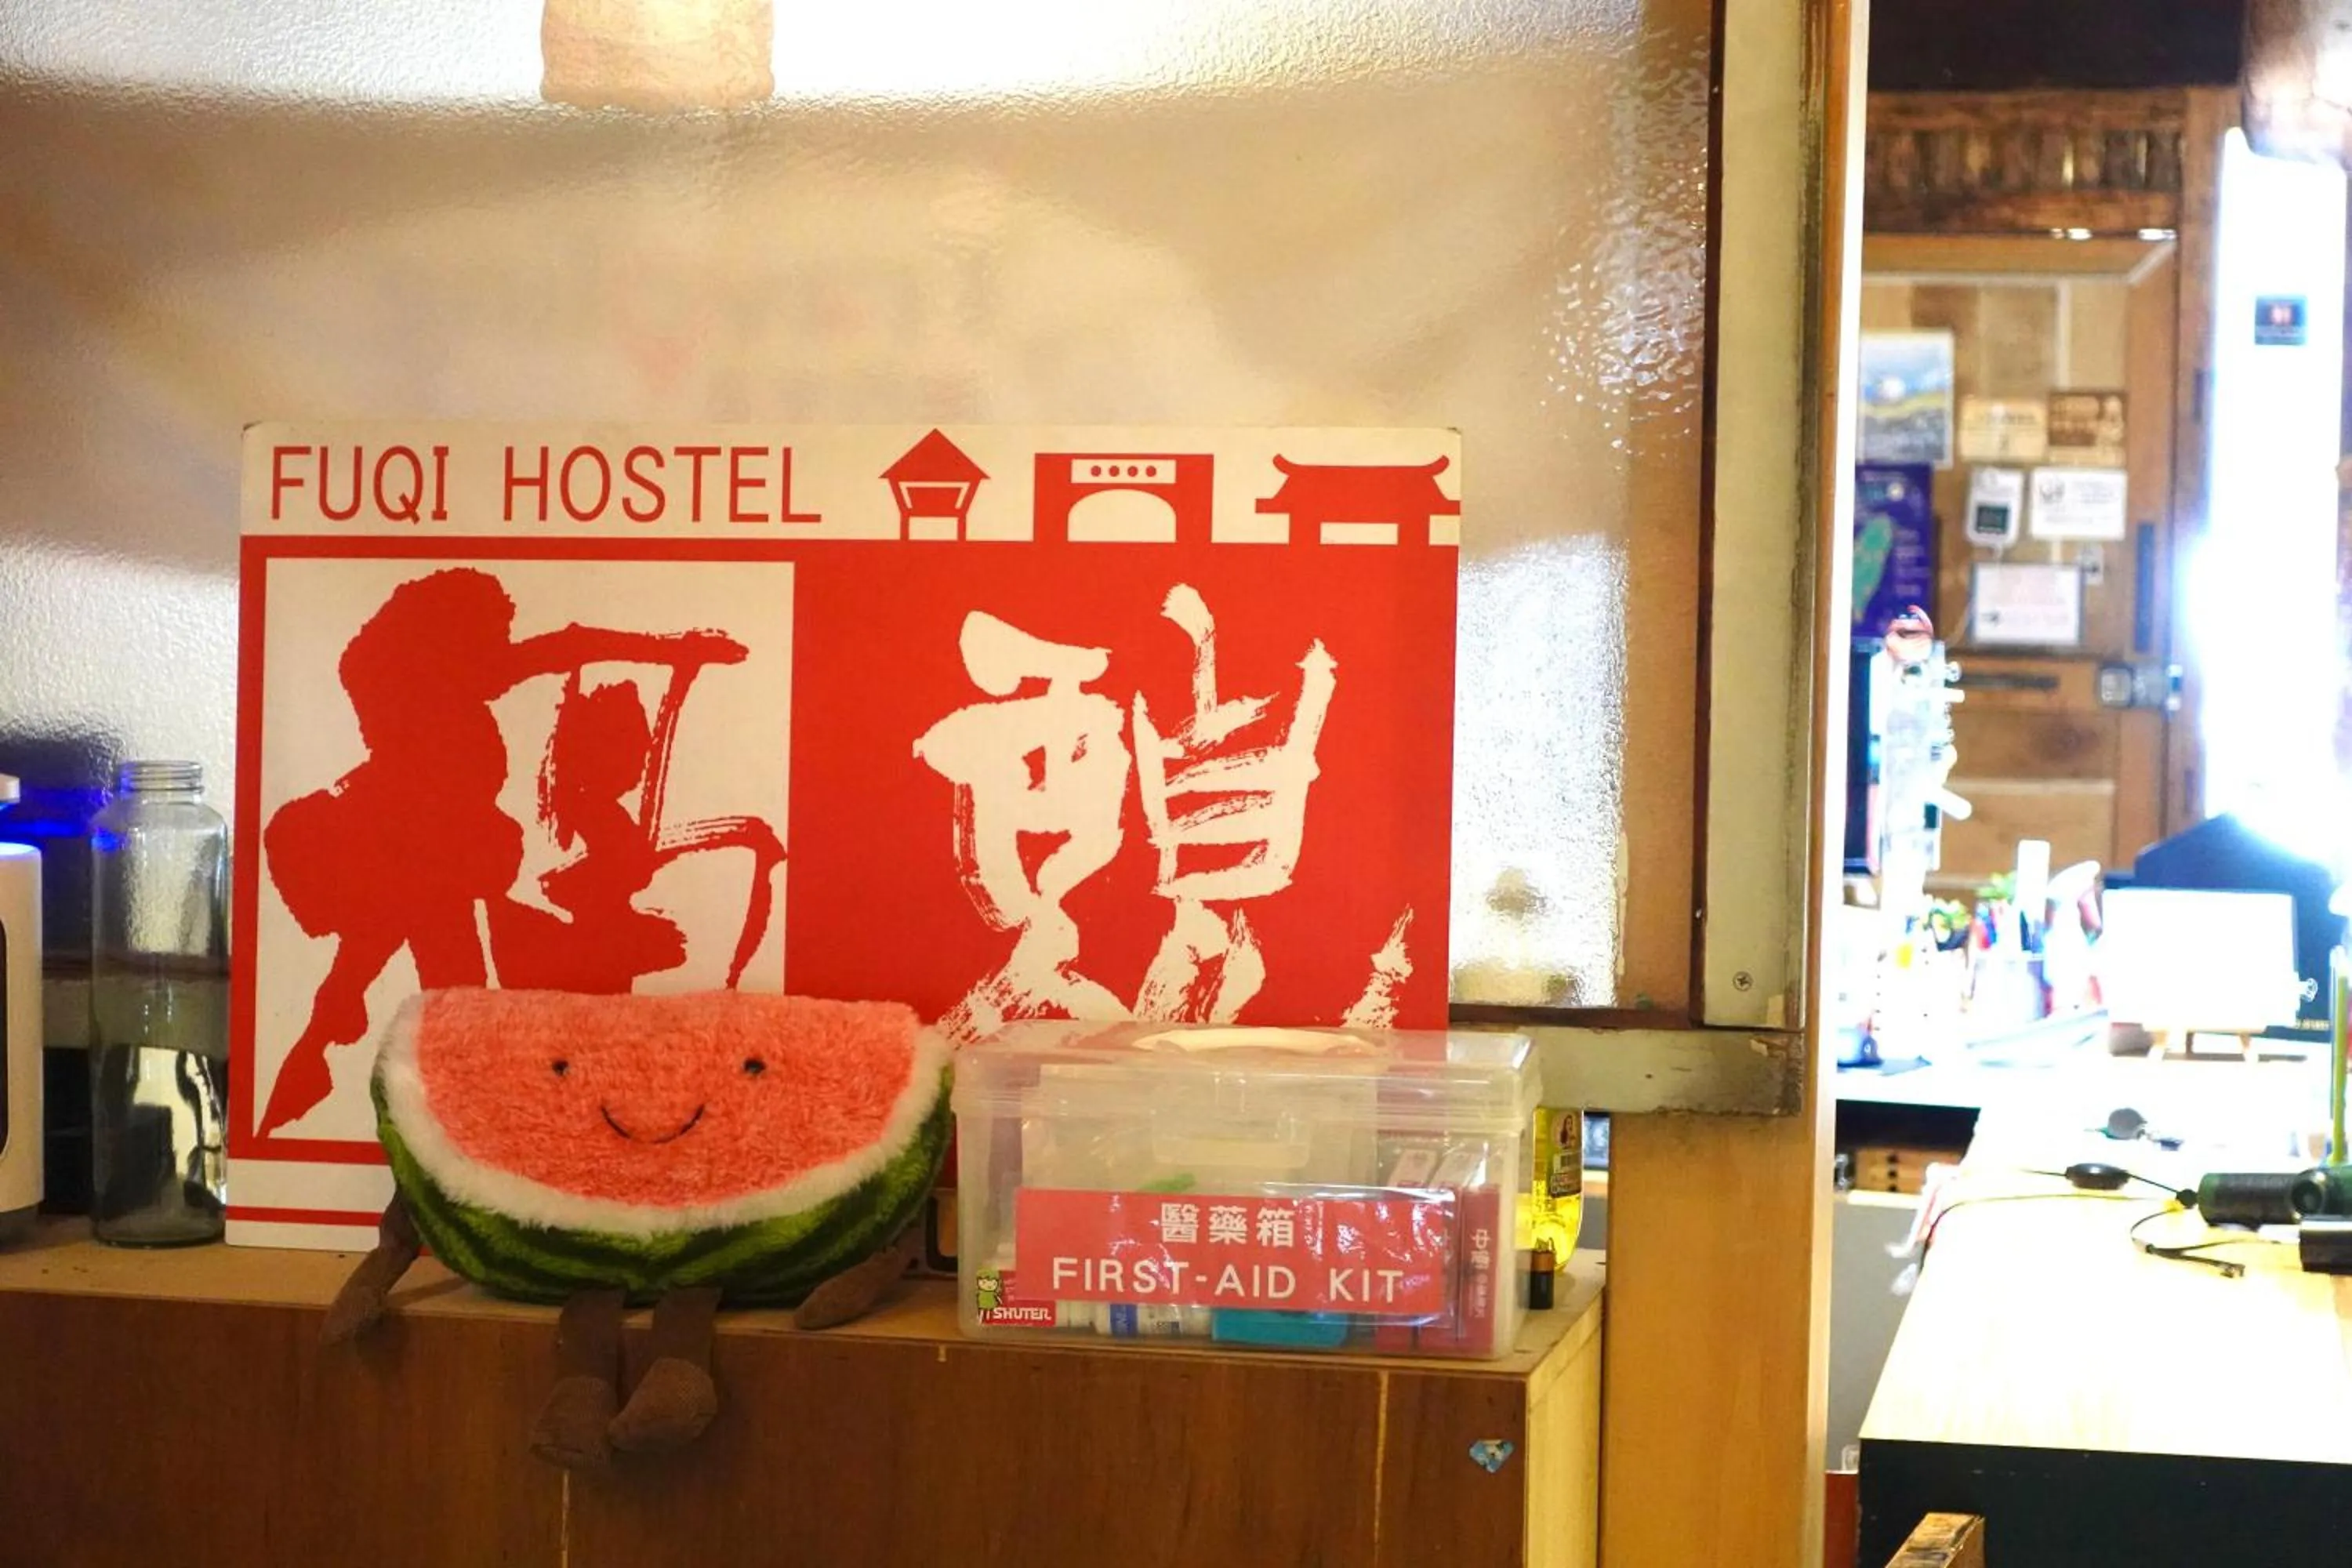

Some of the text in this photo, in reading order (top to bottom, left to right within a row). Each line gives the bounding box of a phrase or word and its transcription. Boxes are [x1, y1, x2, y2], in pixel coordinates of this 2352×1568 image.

[270, 445, 822, 524] FUQI HOSTEL
[1160, 1202, 1296, 1248] 醫藥箱
[1052, 1257, 1297, 1298] FIRST-AID
[1330, 1267, 1404, 1303] KIT
[993, 1306, 1052, 1321] SHUTER
